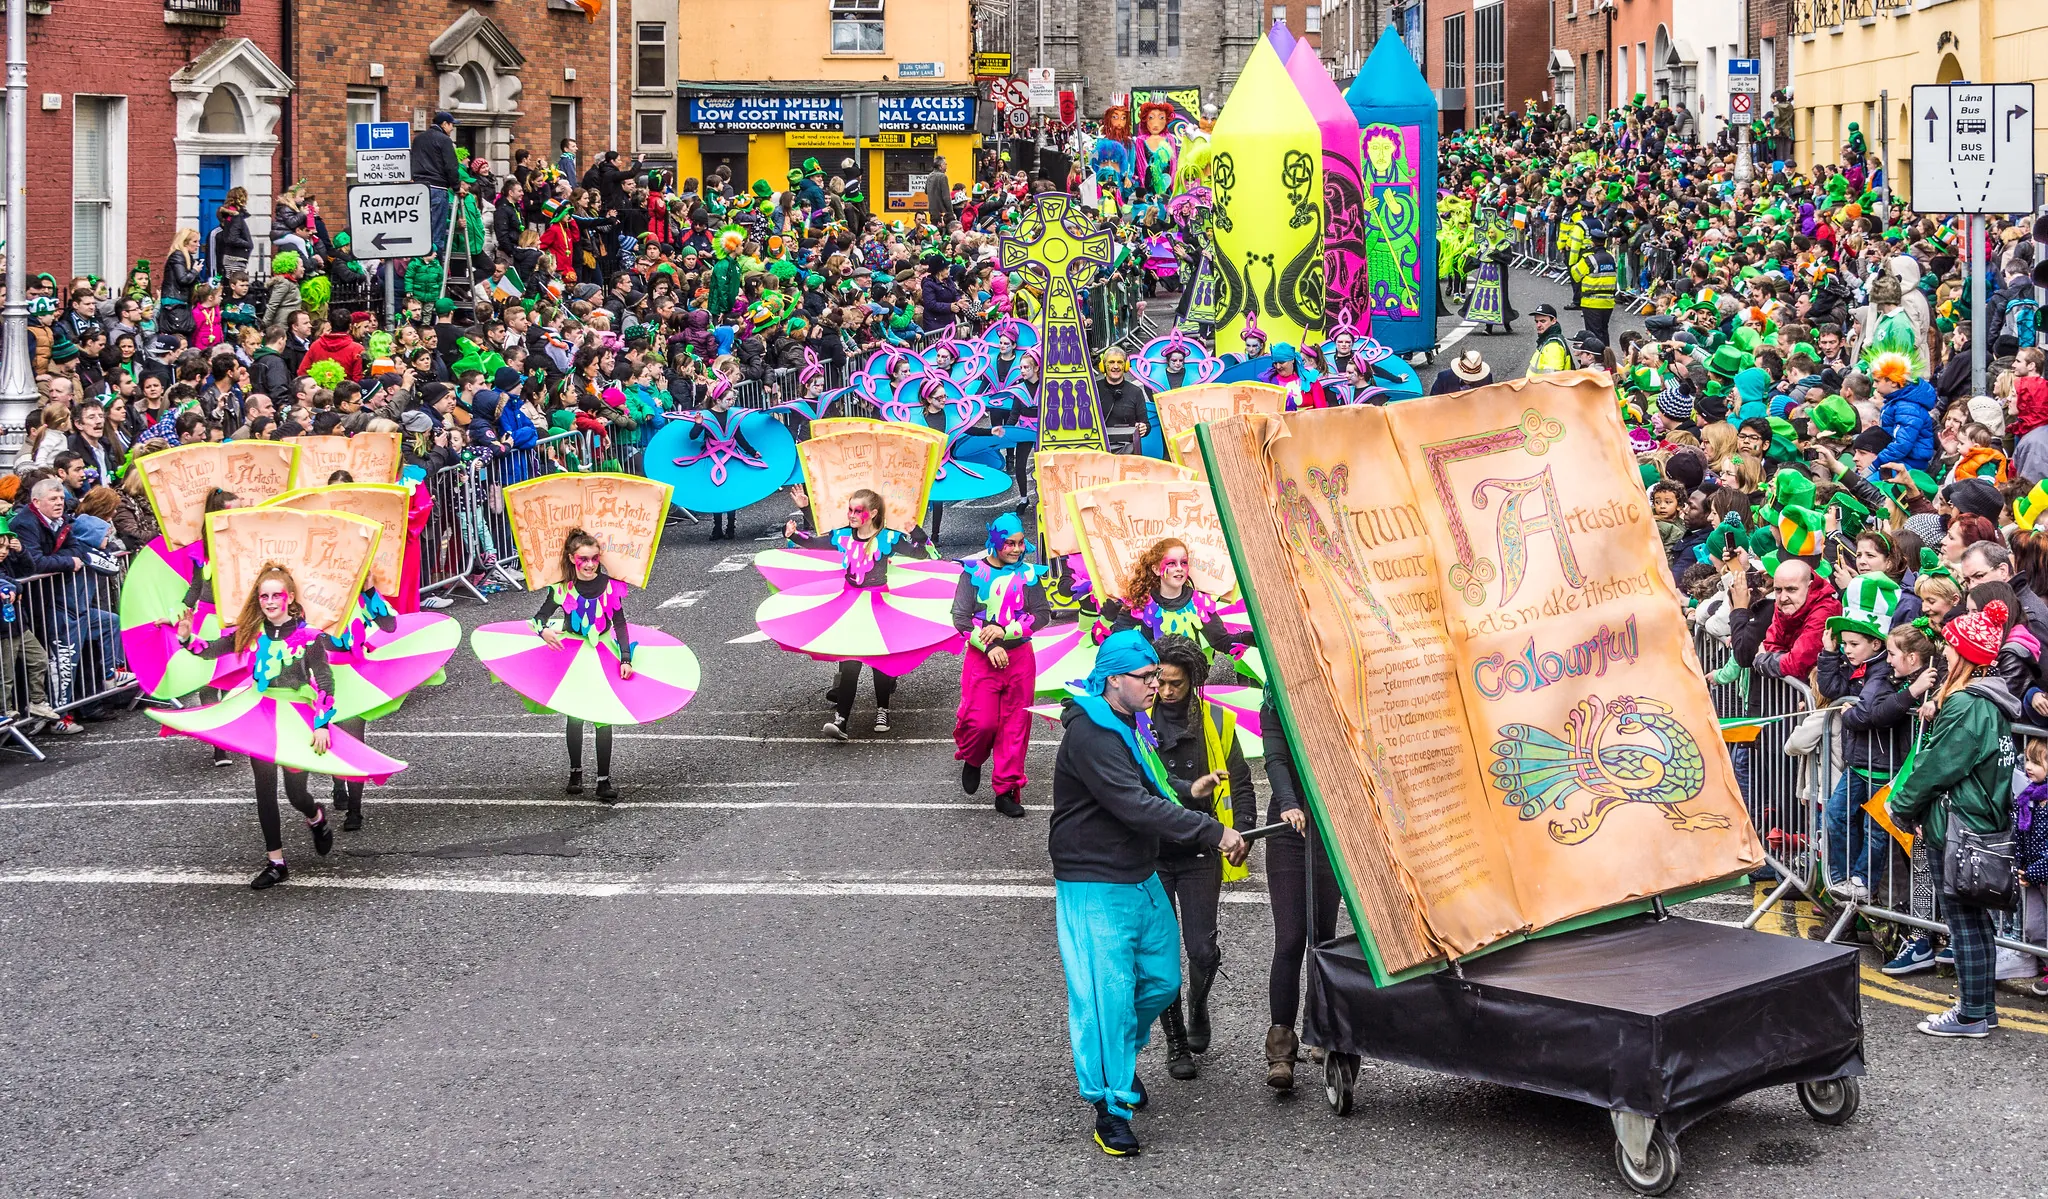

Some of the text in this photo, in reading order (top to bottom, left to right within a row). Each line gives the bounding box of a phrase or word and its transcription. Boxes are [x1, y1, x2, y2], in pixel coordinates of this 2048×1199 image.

[1958, 94, 1983, 102] Lána
[741, 98, 780, 108] HIGH
[785, 98, 830, 108] SPEED
[911, 98, 965, 109] ACCESS
[1961, 106, 1980, 114] Bus
[697, 110, 733, 121] LOW
[738, 110, 778, 121] COST
[917, 111, 965, 122] CALLS
[1013, 112, 1025, 122] 50
[727, 122, 797, 130] PHOTOCOPYING
[913, 134, 935, 146] yes!
[1961, 143, 1982, 151] BUS
[384, 153, 406, 161] Domh
[370, 163, 381, 172] 24
[388, 171, 405, 179] SUN
[359, 192, 423, 208] Rampaí
[891, 198, 906, 207] Ria
[361, 209, 419, 225] RAMPS
[599, 497, 651, 521] Artastic
[1472, 463, 1640, 607] Artastic
[1459, 607, 1517, 642] Let's
[1520, 581, 1580, 624] make
[1582, 570, 1655, 608] History
[1471, 613, 1639, 701] Colourful
